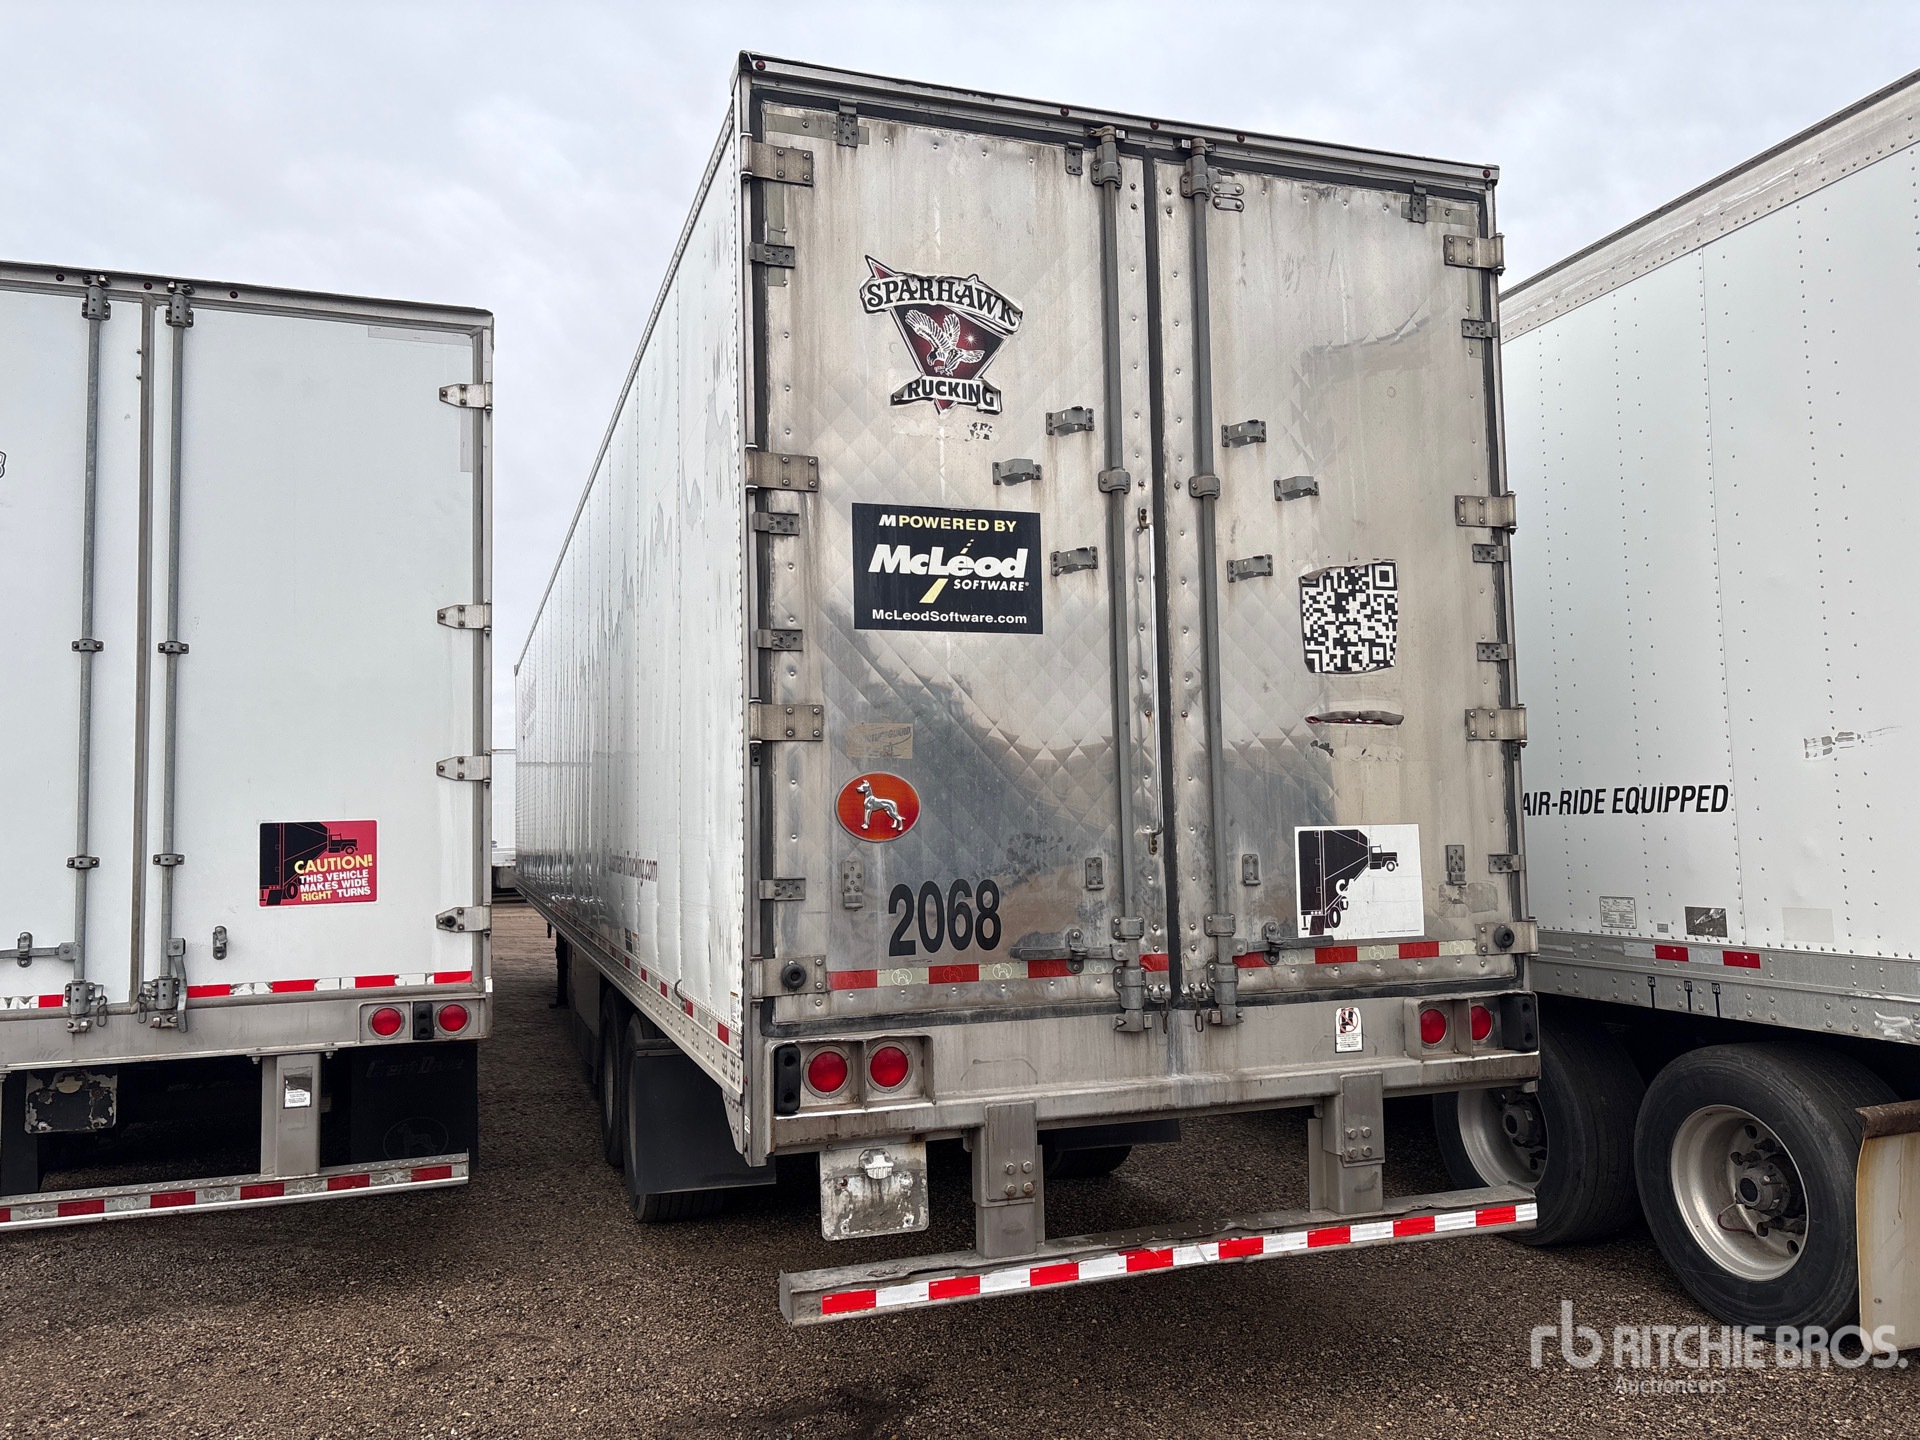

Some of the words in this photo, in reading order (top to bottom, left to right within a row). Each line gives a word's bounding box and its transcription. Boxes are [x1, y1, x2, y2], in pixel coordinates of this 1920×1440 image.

[867, 277, 1020, 327] SPARHAWK
[907, 379, 995, 407] RUCKING
[879, 514, 990, 532] MPOWERED
[994, 520, 1017, 533] BY
[872, 609, 1027, 624] McLeodSoftware.com
[1523, 788, 1606, 816] AIR-RIDE
[1612, 784, 1729, 815] EQUIPPED
[294, 854, 372, 874] CAUTION!
[299, 875, 323, 884] THIS
[325, 869, 369, 881] VEHICLE
[300, 883, 338, 892] MAKES
[341, 878, 368, 888] WIDE
[301, 892, 332, 902] RIGHT
[337, 887, 371, 898] TURNS
[888, 878, 1002, 957] 2068
